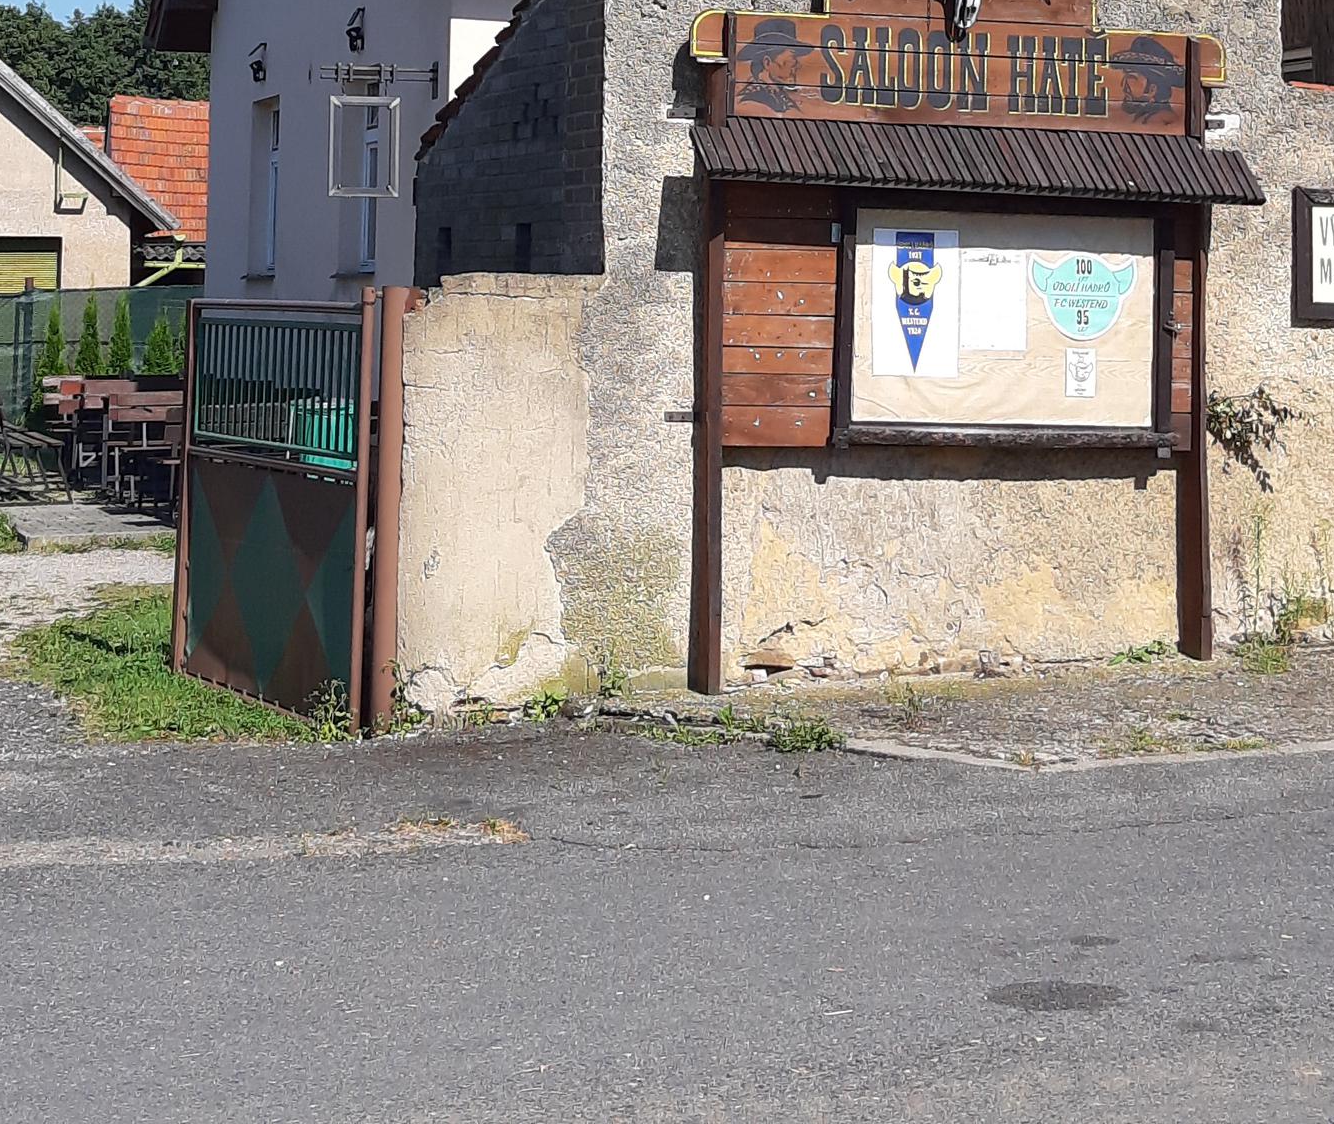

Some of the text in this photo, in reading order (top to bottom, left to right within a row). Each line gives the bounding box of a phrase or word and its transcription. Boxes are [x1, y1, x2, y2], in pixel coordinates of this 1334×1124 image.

[819, 23, 991, 113] SALOON
[1075, 259, 1093, 275] 100
[1076, 310, 1090, 325] 95
